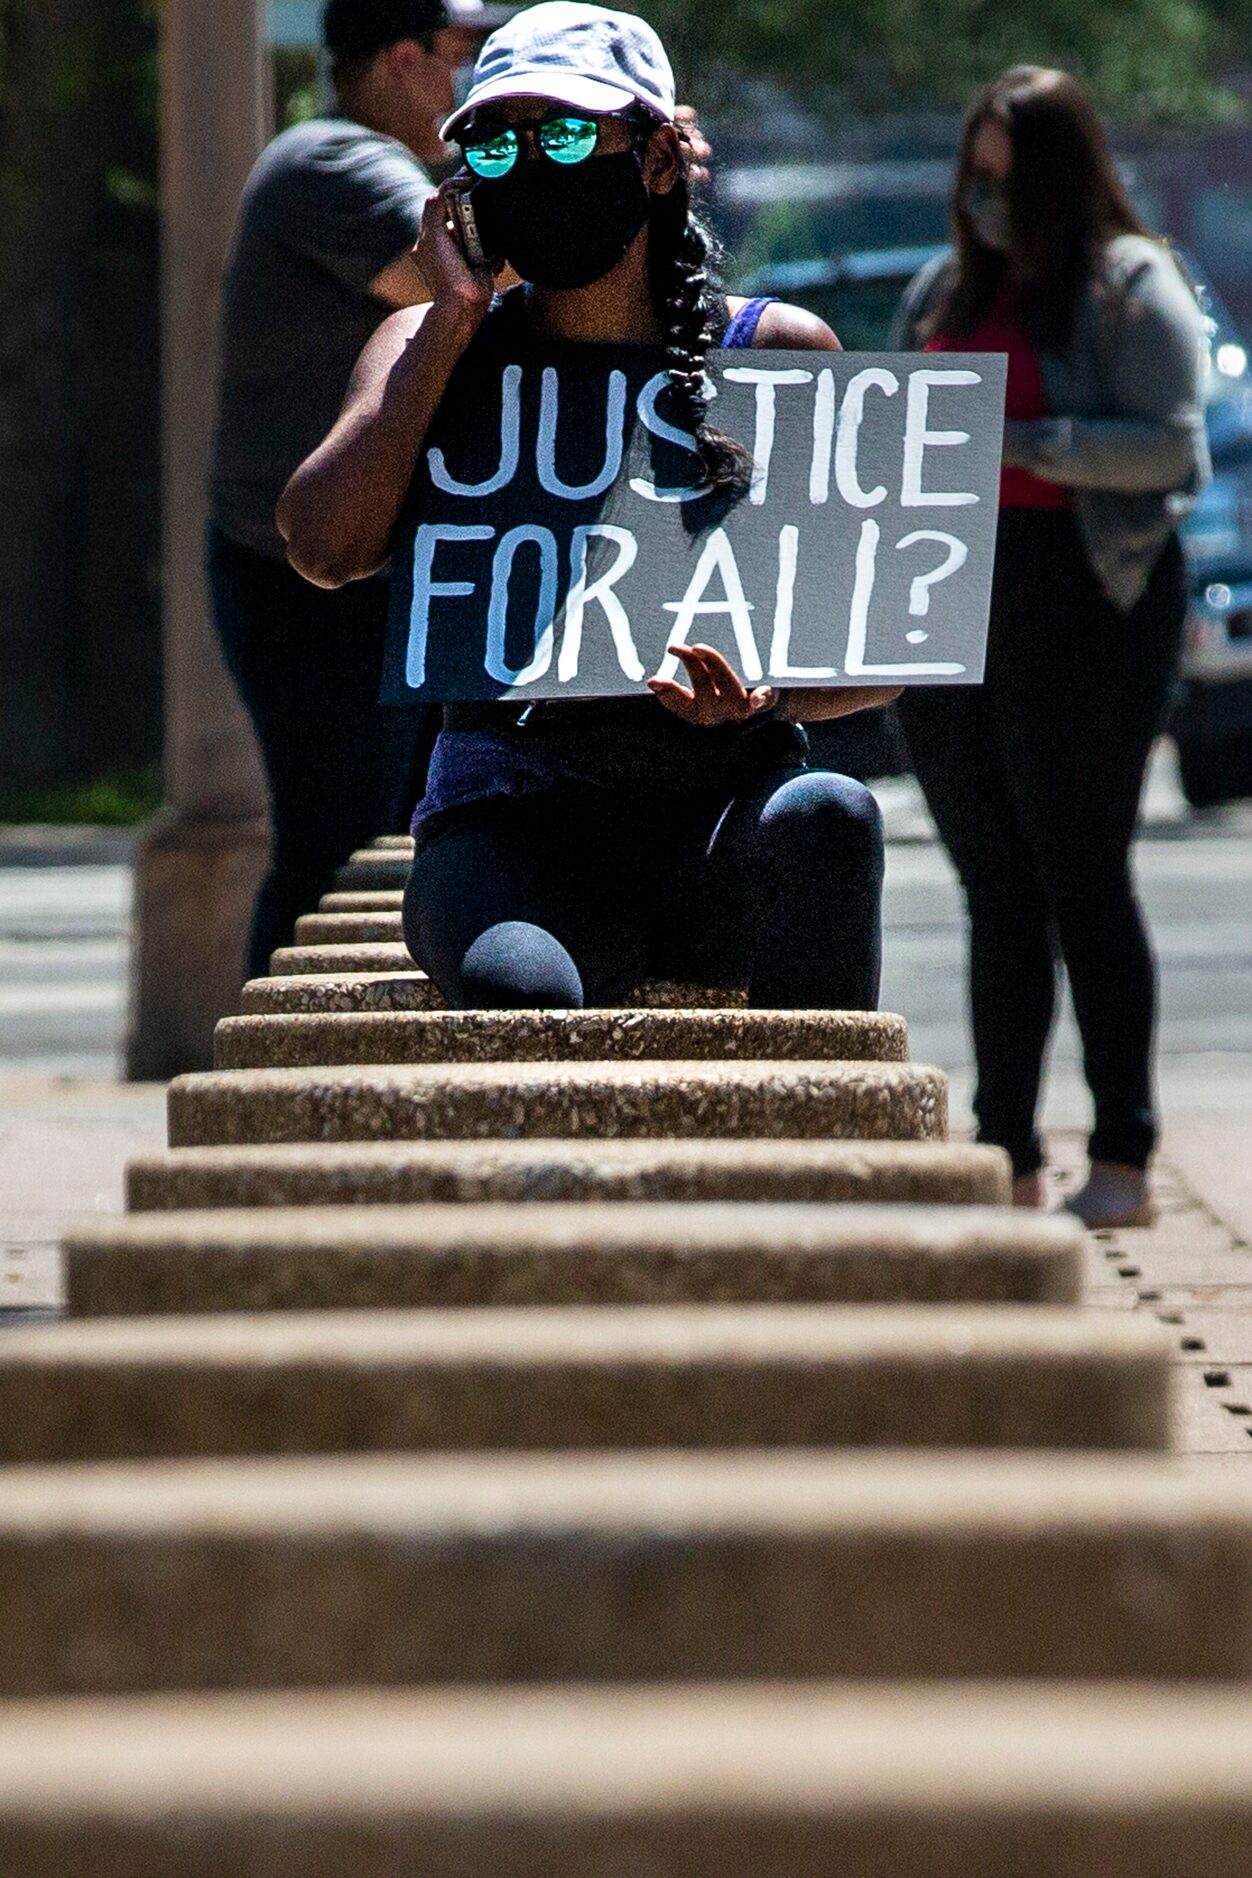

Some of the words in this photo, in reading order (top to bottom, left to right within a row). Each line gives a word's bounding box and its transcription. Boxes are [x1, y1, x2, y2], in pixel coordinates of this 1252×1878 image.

[427, 364, 982, 509] JUSTICE
[406, 523, 646, 689] FOR
[655, 519, 969, 682] ALL?
